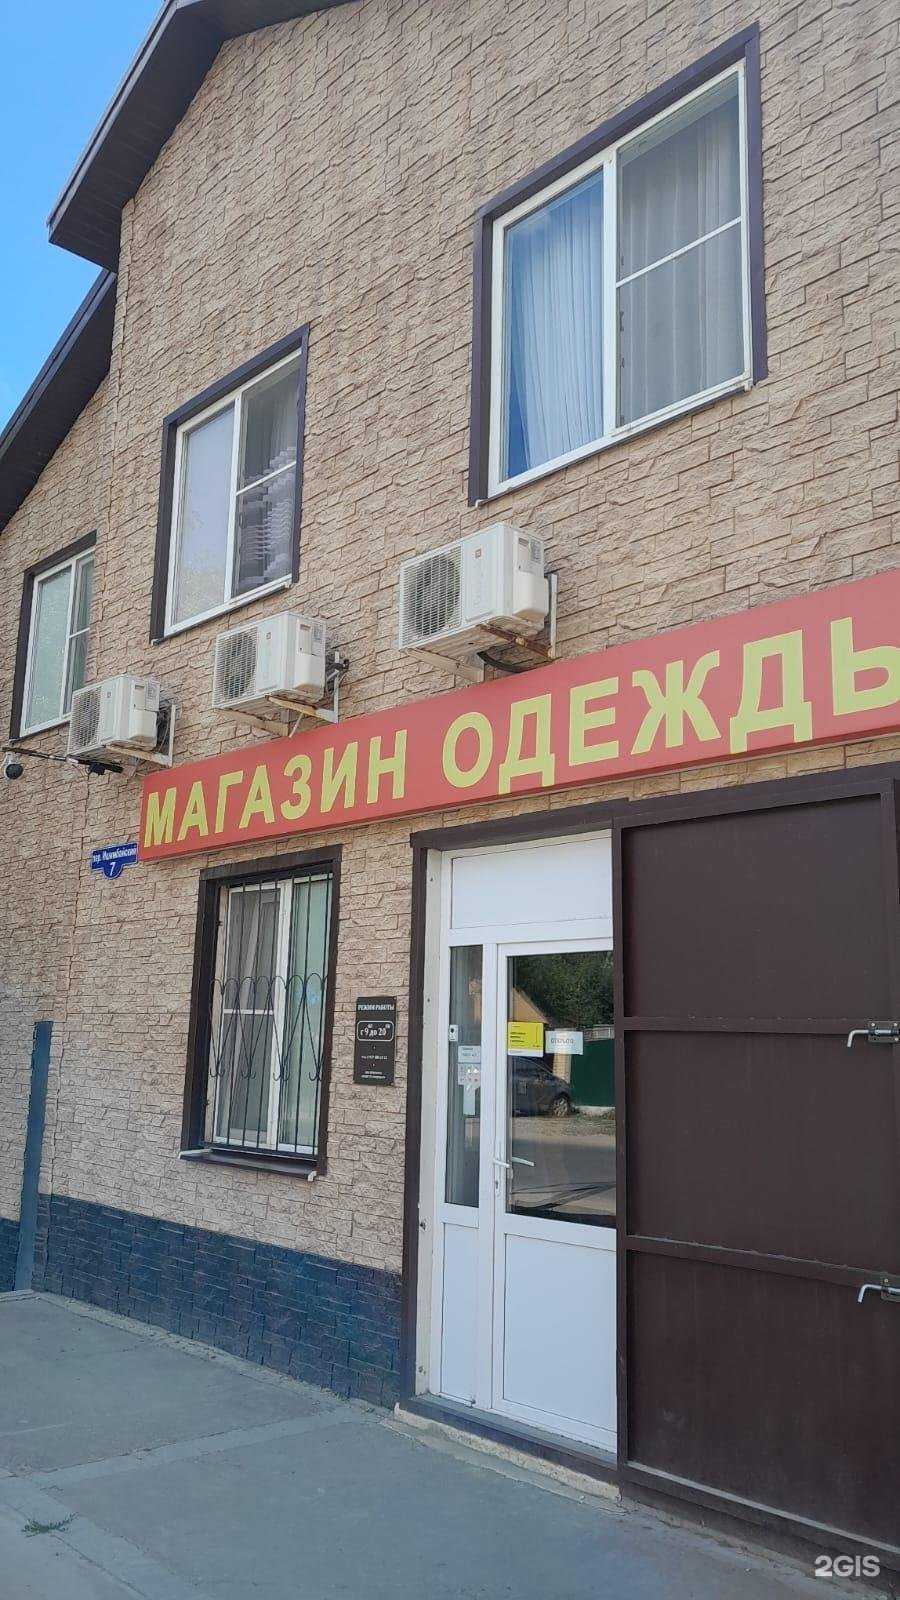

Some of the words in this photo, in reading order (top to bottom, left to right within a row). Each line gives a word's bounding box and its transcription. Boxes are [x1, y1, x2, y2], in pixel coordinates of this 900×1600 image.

[144, 730, 406, 848] МАГАЗИН
[110, 861, 116, 876] 7
[369, 1029, 378, 1037] до
